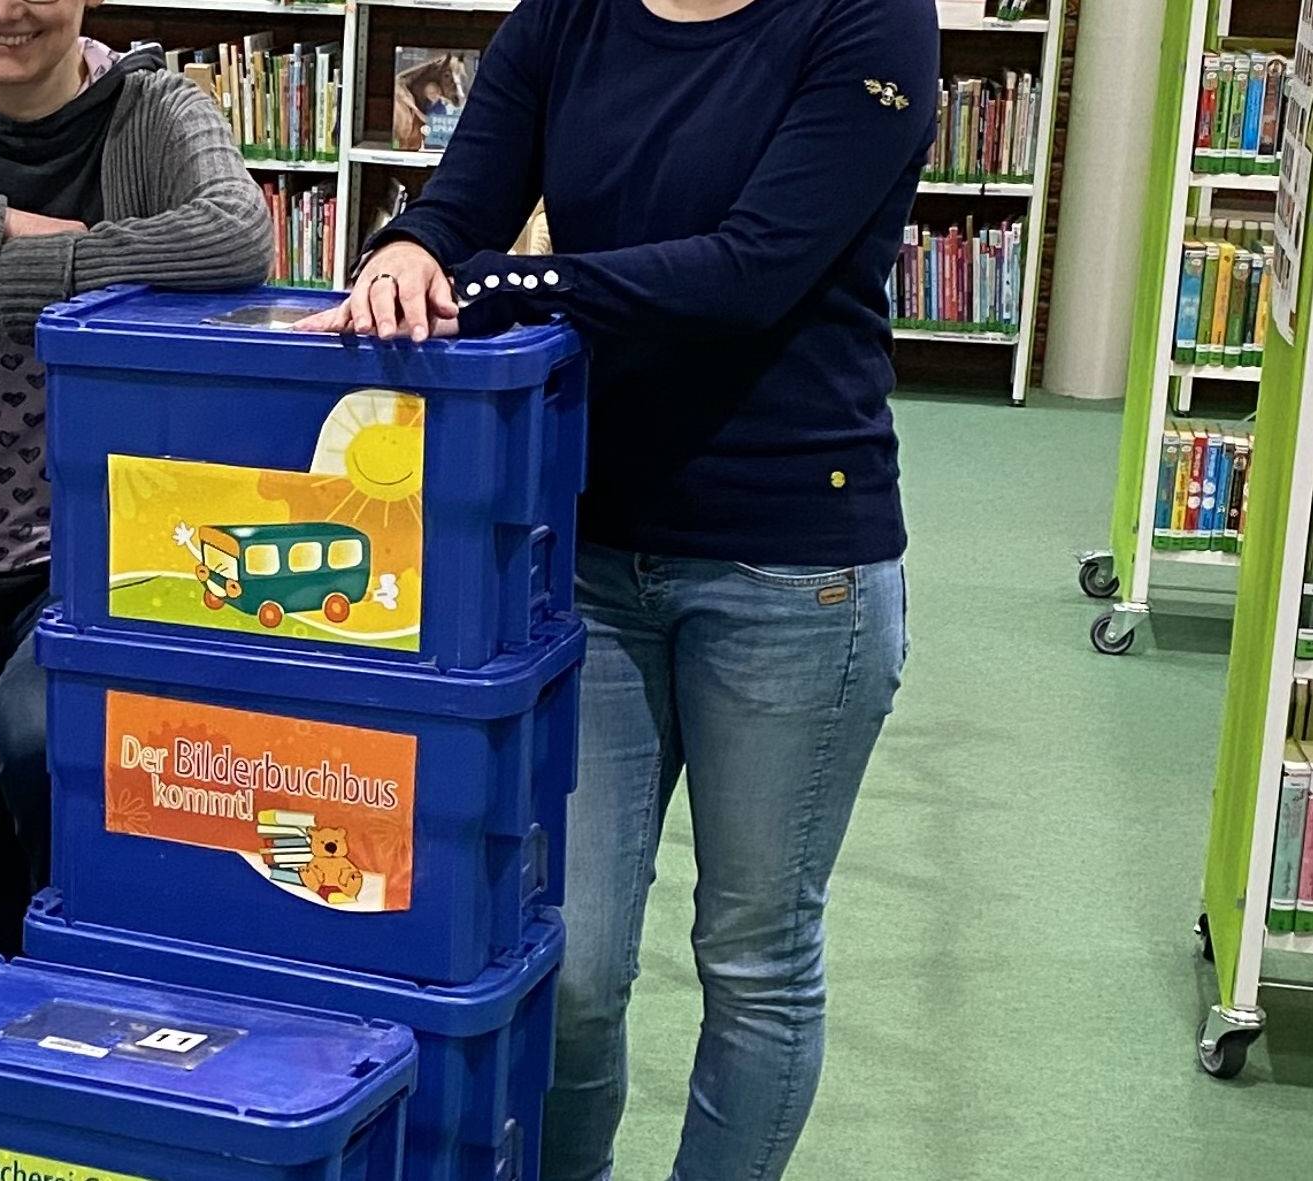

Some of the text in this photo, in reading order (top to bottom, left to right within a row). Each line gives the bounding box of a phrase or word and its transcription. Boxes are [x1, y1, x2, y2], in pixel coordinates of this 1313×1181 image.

[120, 734, 398, 810] Der Bilderbuchbus
[152, 773, 254, 821] kommt!
[156, 1033, 193, 1046] 11
